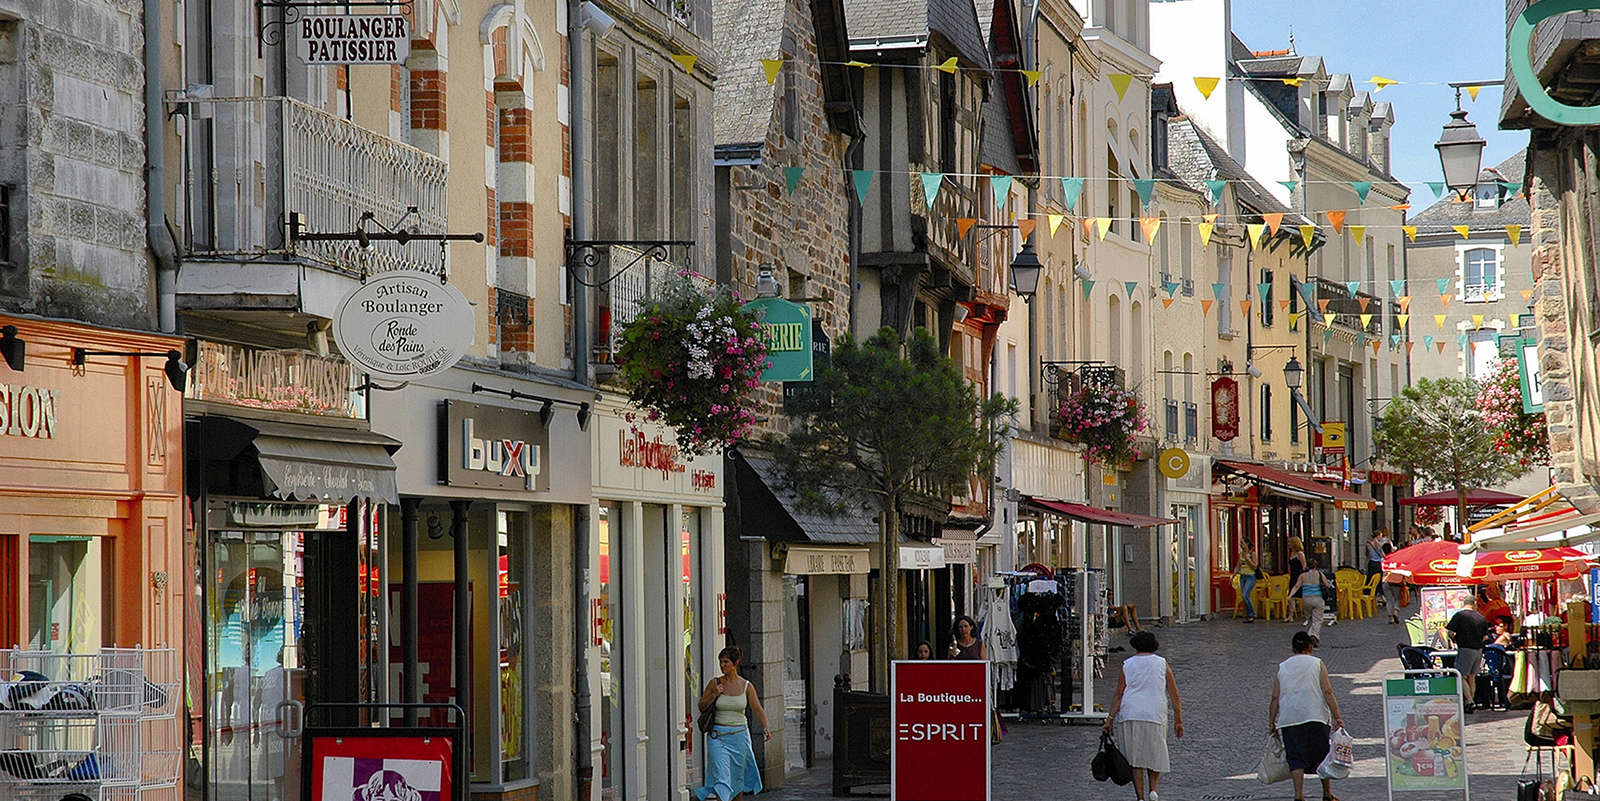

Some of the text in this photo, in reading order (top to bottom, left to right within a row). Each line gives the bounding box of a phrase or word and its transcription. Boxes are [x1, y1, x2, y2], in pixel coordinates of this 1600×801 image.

[302, 17, 406, 39] BOULANGER
[308, 40, 397, 62] PATISSIER
[376, 281, 429, 299] Artisan
[361, 299, 443, 317] Boulanger
[386, 320, 418, 340] Ronde
[378, 336, 425, 356] des Pains
[353, 344, 387, 370] Véronique
[395, 362, 411, 371] Loïc
[463, 418, 541, 491] buxy
[900, 692, 982, 704] La Boutique...
[899, 723, 983, 741] ESPRIT
